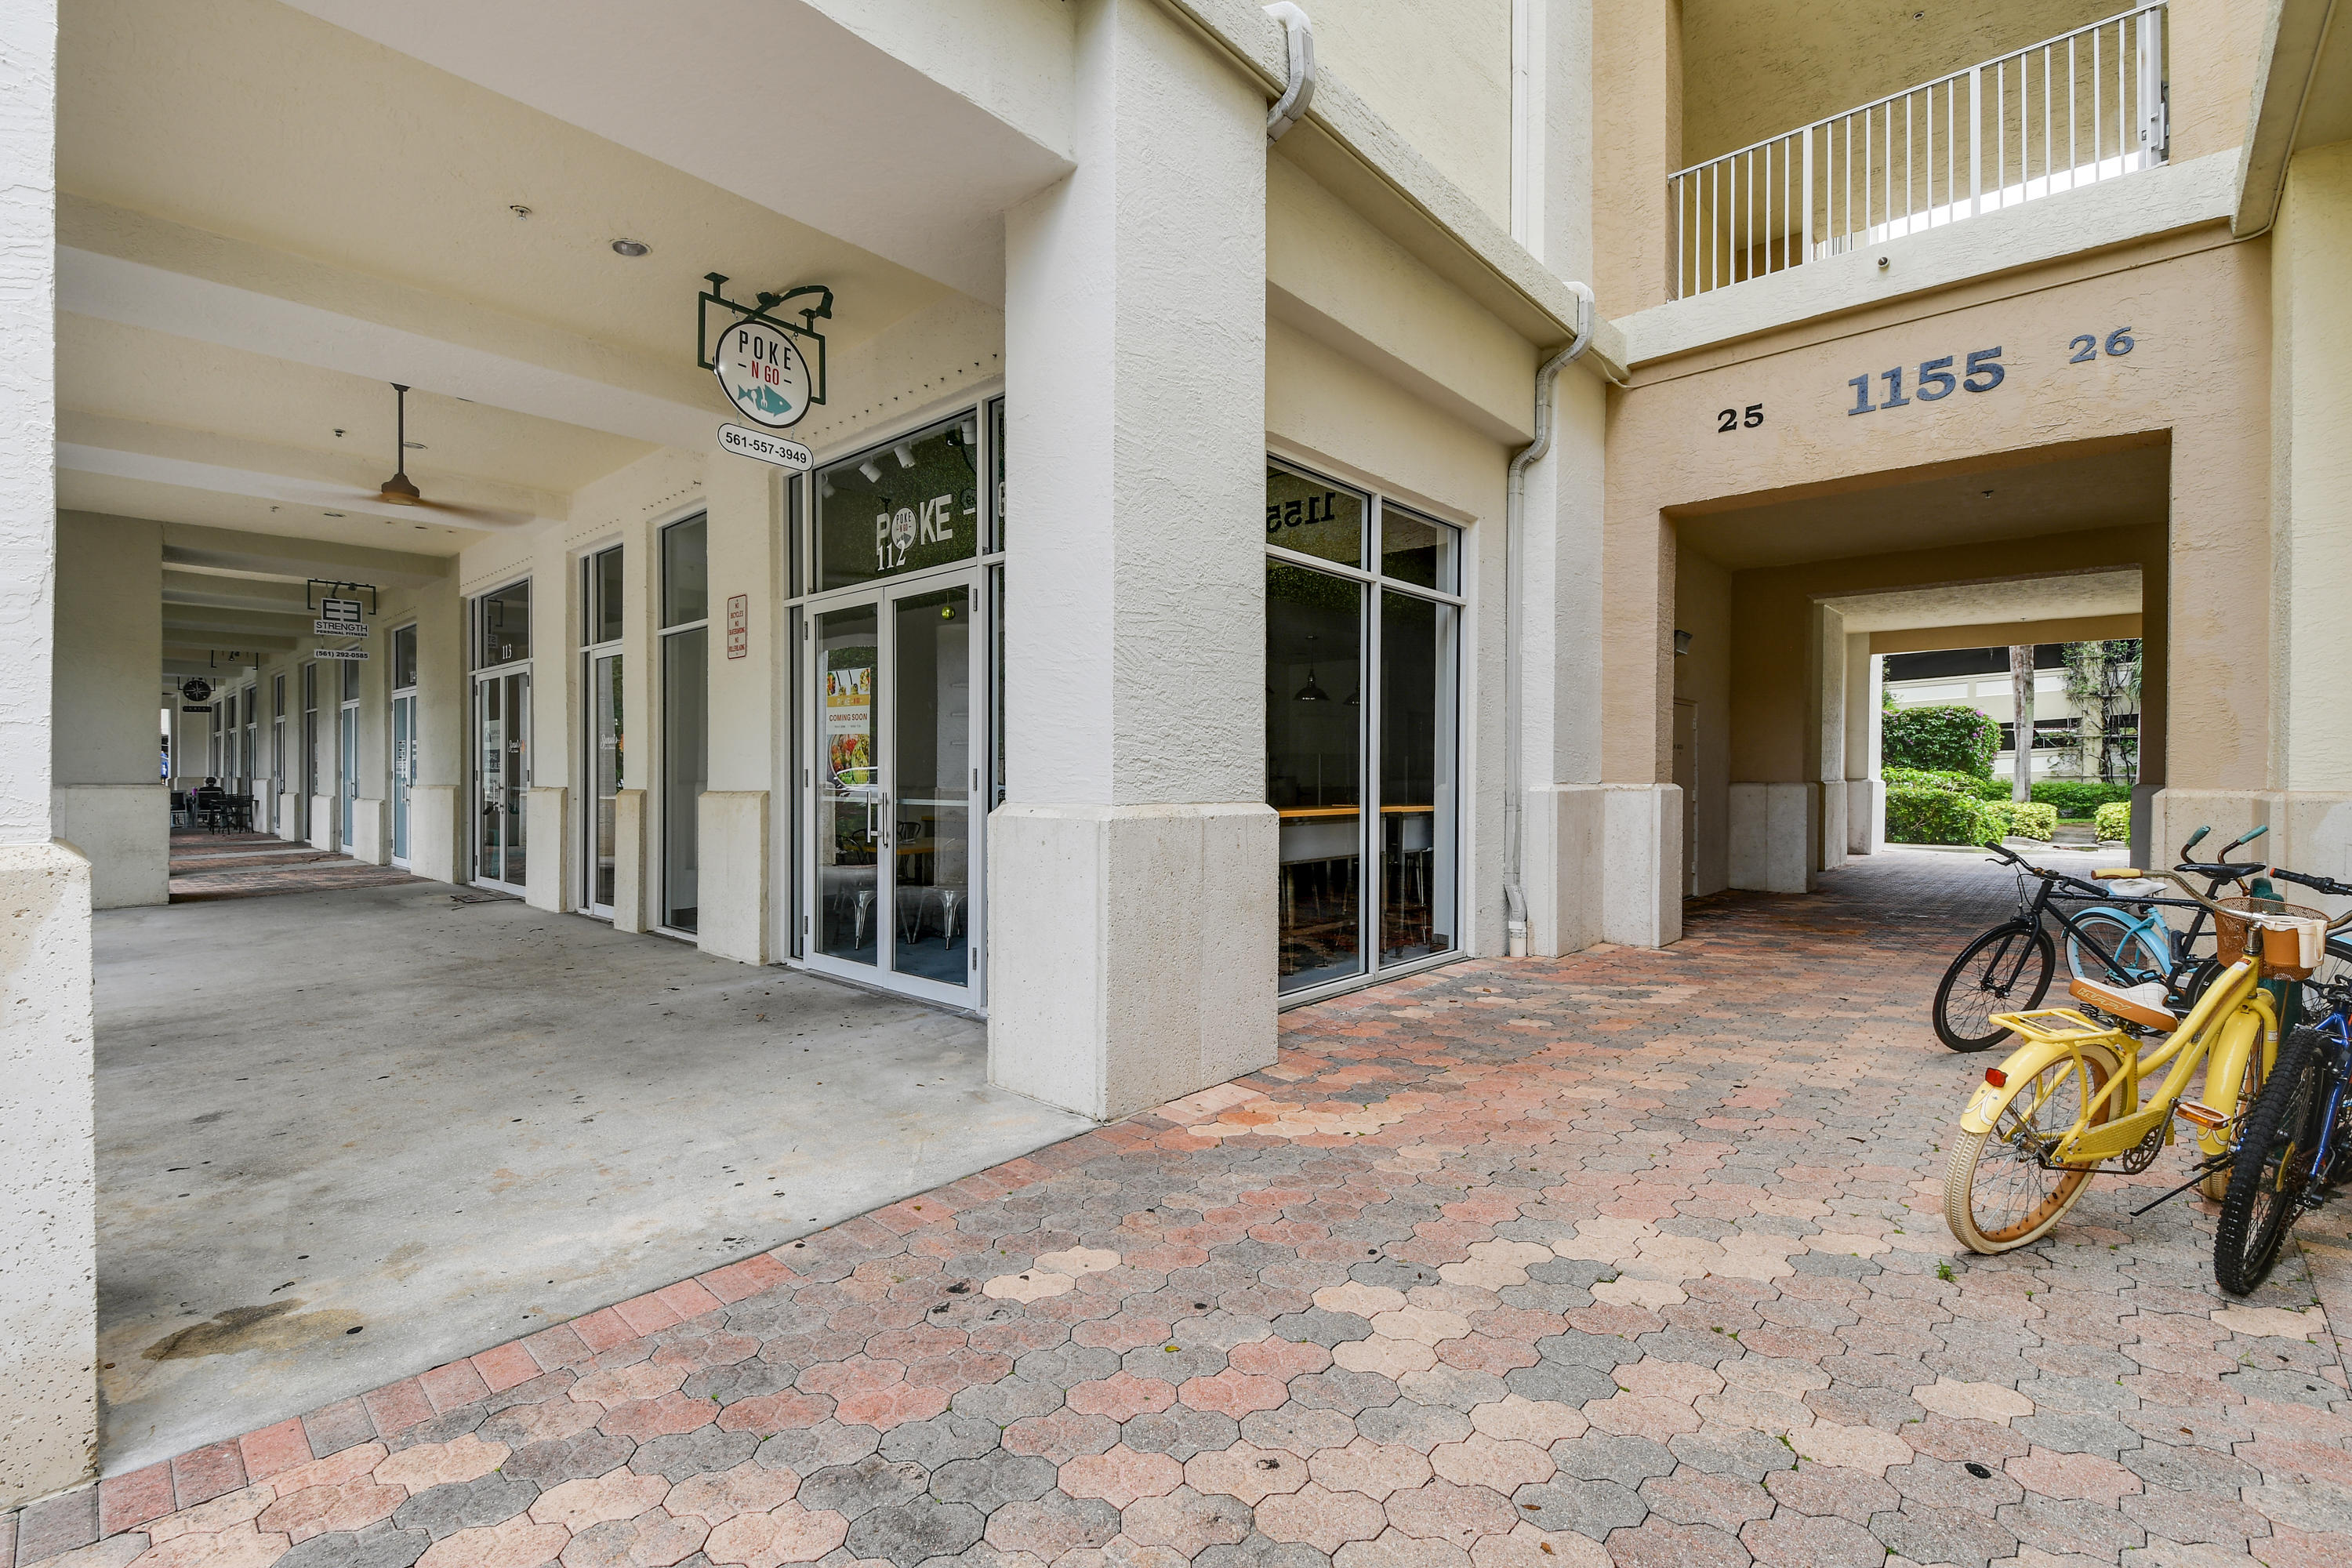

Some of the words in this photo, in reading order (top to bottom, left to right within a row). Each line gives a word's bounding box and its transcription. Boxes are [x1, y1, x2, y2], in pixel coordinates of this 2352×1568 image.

[739, 330, 792, 371] POKE
[2069, 326, 2135, 365] 26
[751, 360, 759, 379] N
[764, 367, 779, 386] GO
[1847, 346, 2005, 416] 1155
[1717, 403, 1764, 434] 25
[725, 432, 807, 463] 561-557-3949
[896, 512, 911, 524] POKE
[877, 540, 906, 571] 112
[316, 621, 368, 633] STRENGTH
[503, 644, 512, 659] 113
[2077, 987, 2132, 1011] HUFFY
